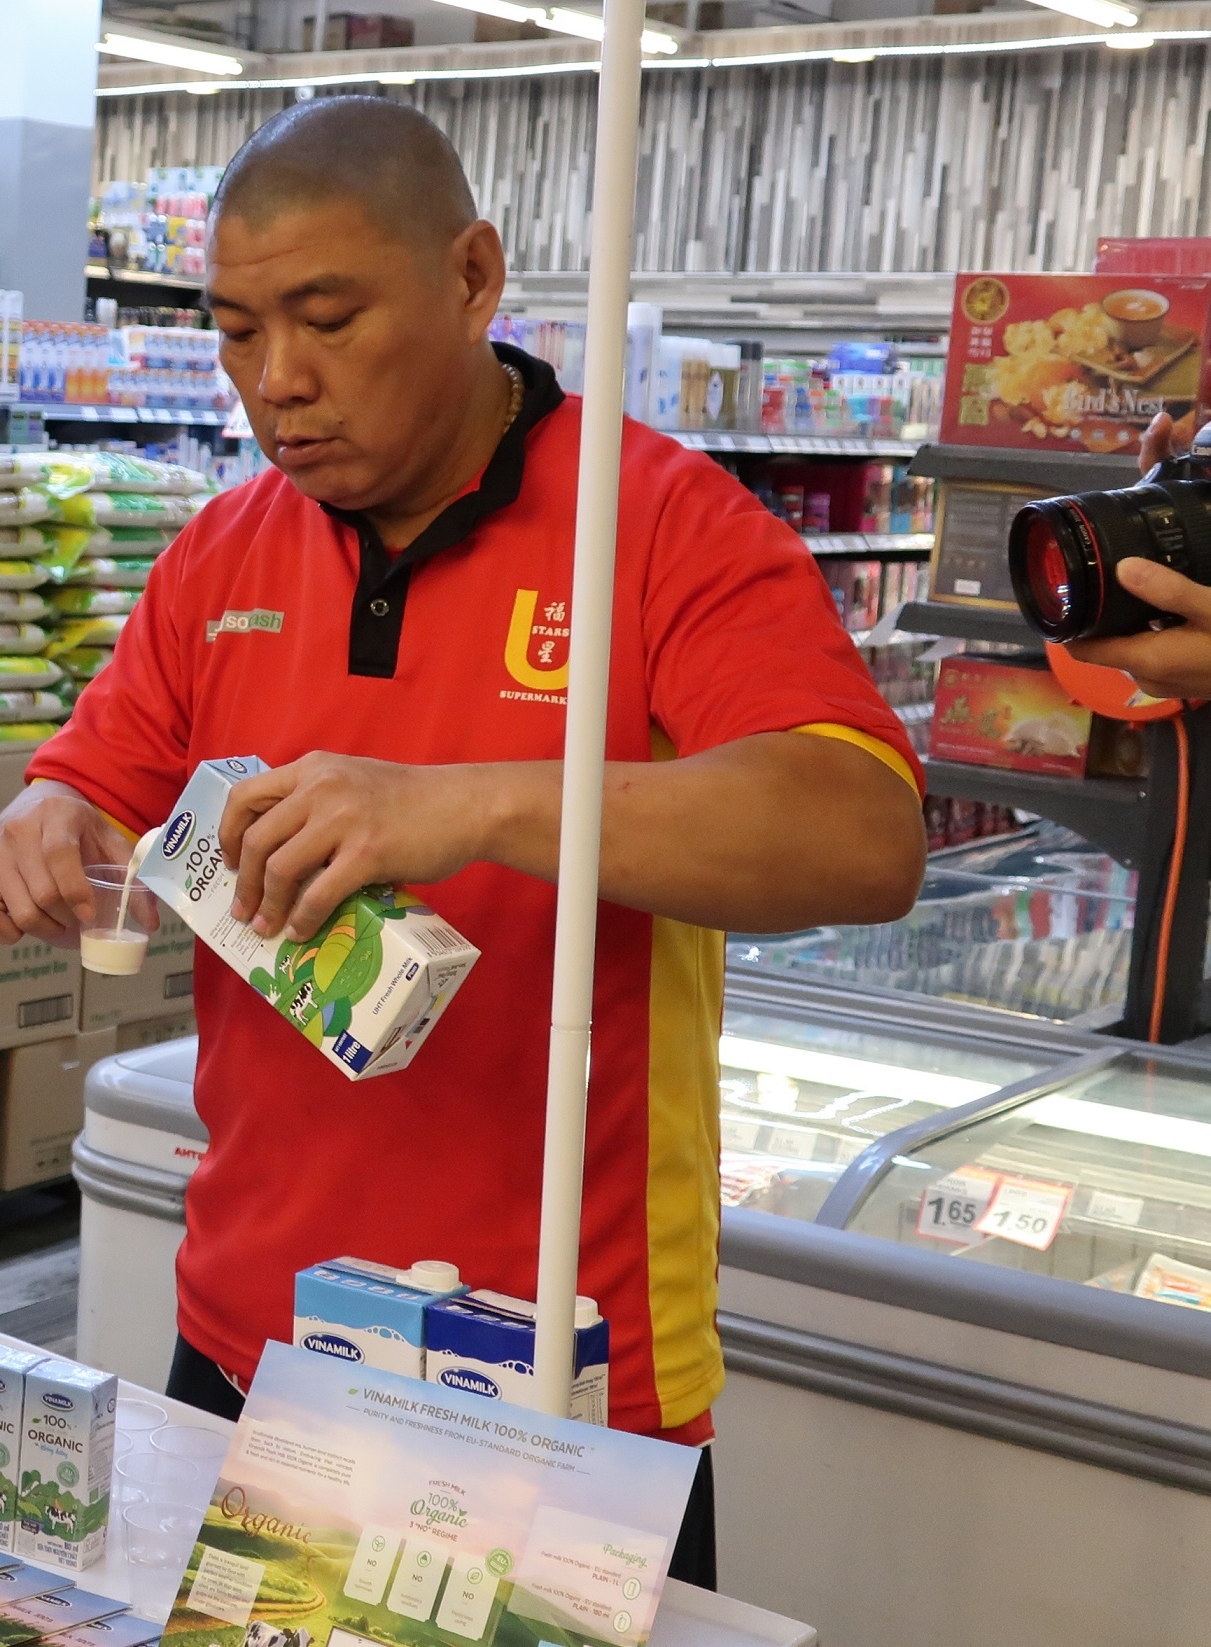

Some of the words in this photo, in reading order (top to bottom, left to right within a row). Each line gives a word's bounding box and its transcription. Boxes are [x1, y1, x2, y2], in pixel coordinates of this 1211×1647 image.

[531, 625, 570, 637] STARS
[163, 813, 191, 854] VINAMILK
[381, 984, 393, 1002] Fresh
[391, 968, 405, 986] Whole
[403, 957, 413, 970] Milk
[305, 1336, 359, 1361] VINAMILK
[443, 1371, 496, 1397] VINAMILK
[363, 1388, 419, 1413] VINAMILK
[419, 1403, 458, 1424] FRESH
[461, 1413, 490, 1432] MILK
[494, 1423, 527, 1443] 100%
[530, 1434, 586, 1458] ORGANIC
[27, 1429, 83, 1453] ORGANIC
[363, 1408, 389, 1420] PURITY
[390, 1416, 404, 1426] AND
[405, 1419, 443, 1436] FRESHNESS
[444, 1429, 465, 1441] FROM
[466, 1435, 521, 1458] EU-STANDARD
[522, 1452, 557, 1467] ORGANIC
[557, 1460, 575, 1472] FARM
[410, 1499, 469, 1528] Organic
[429, 1492, 459, 1512] 100%
[221, 1486, 311, 1544] Organic
[432, 1528, 458, 1542] REGIME
[367, 1558, 377, 1567] NO
[603, 1544, 648, 1569] Packaging
[411, 1574, 423, 1582] NO
[462, 1591, 474, 1600] NO
